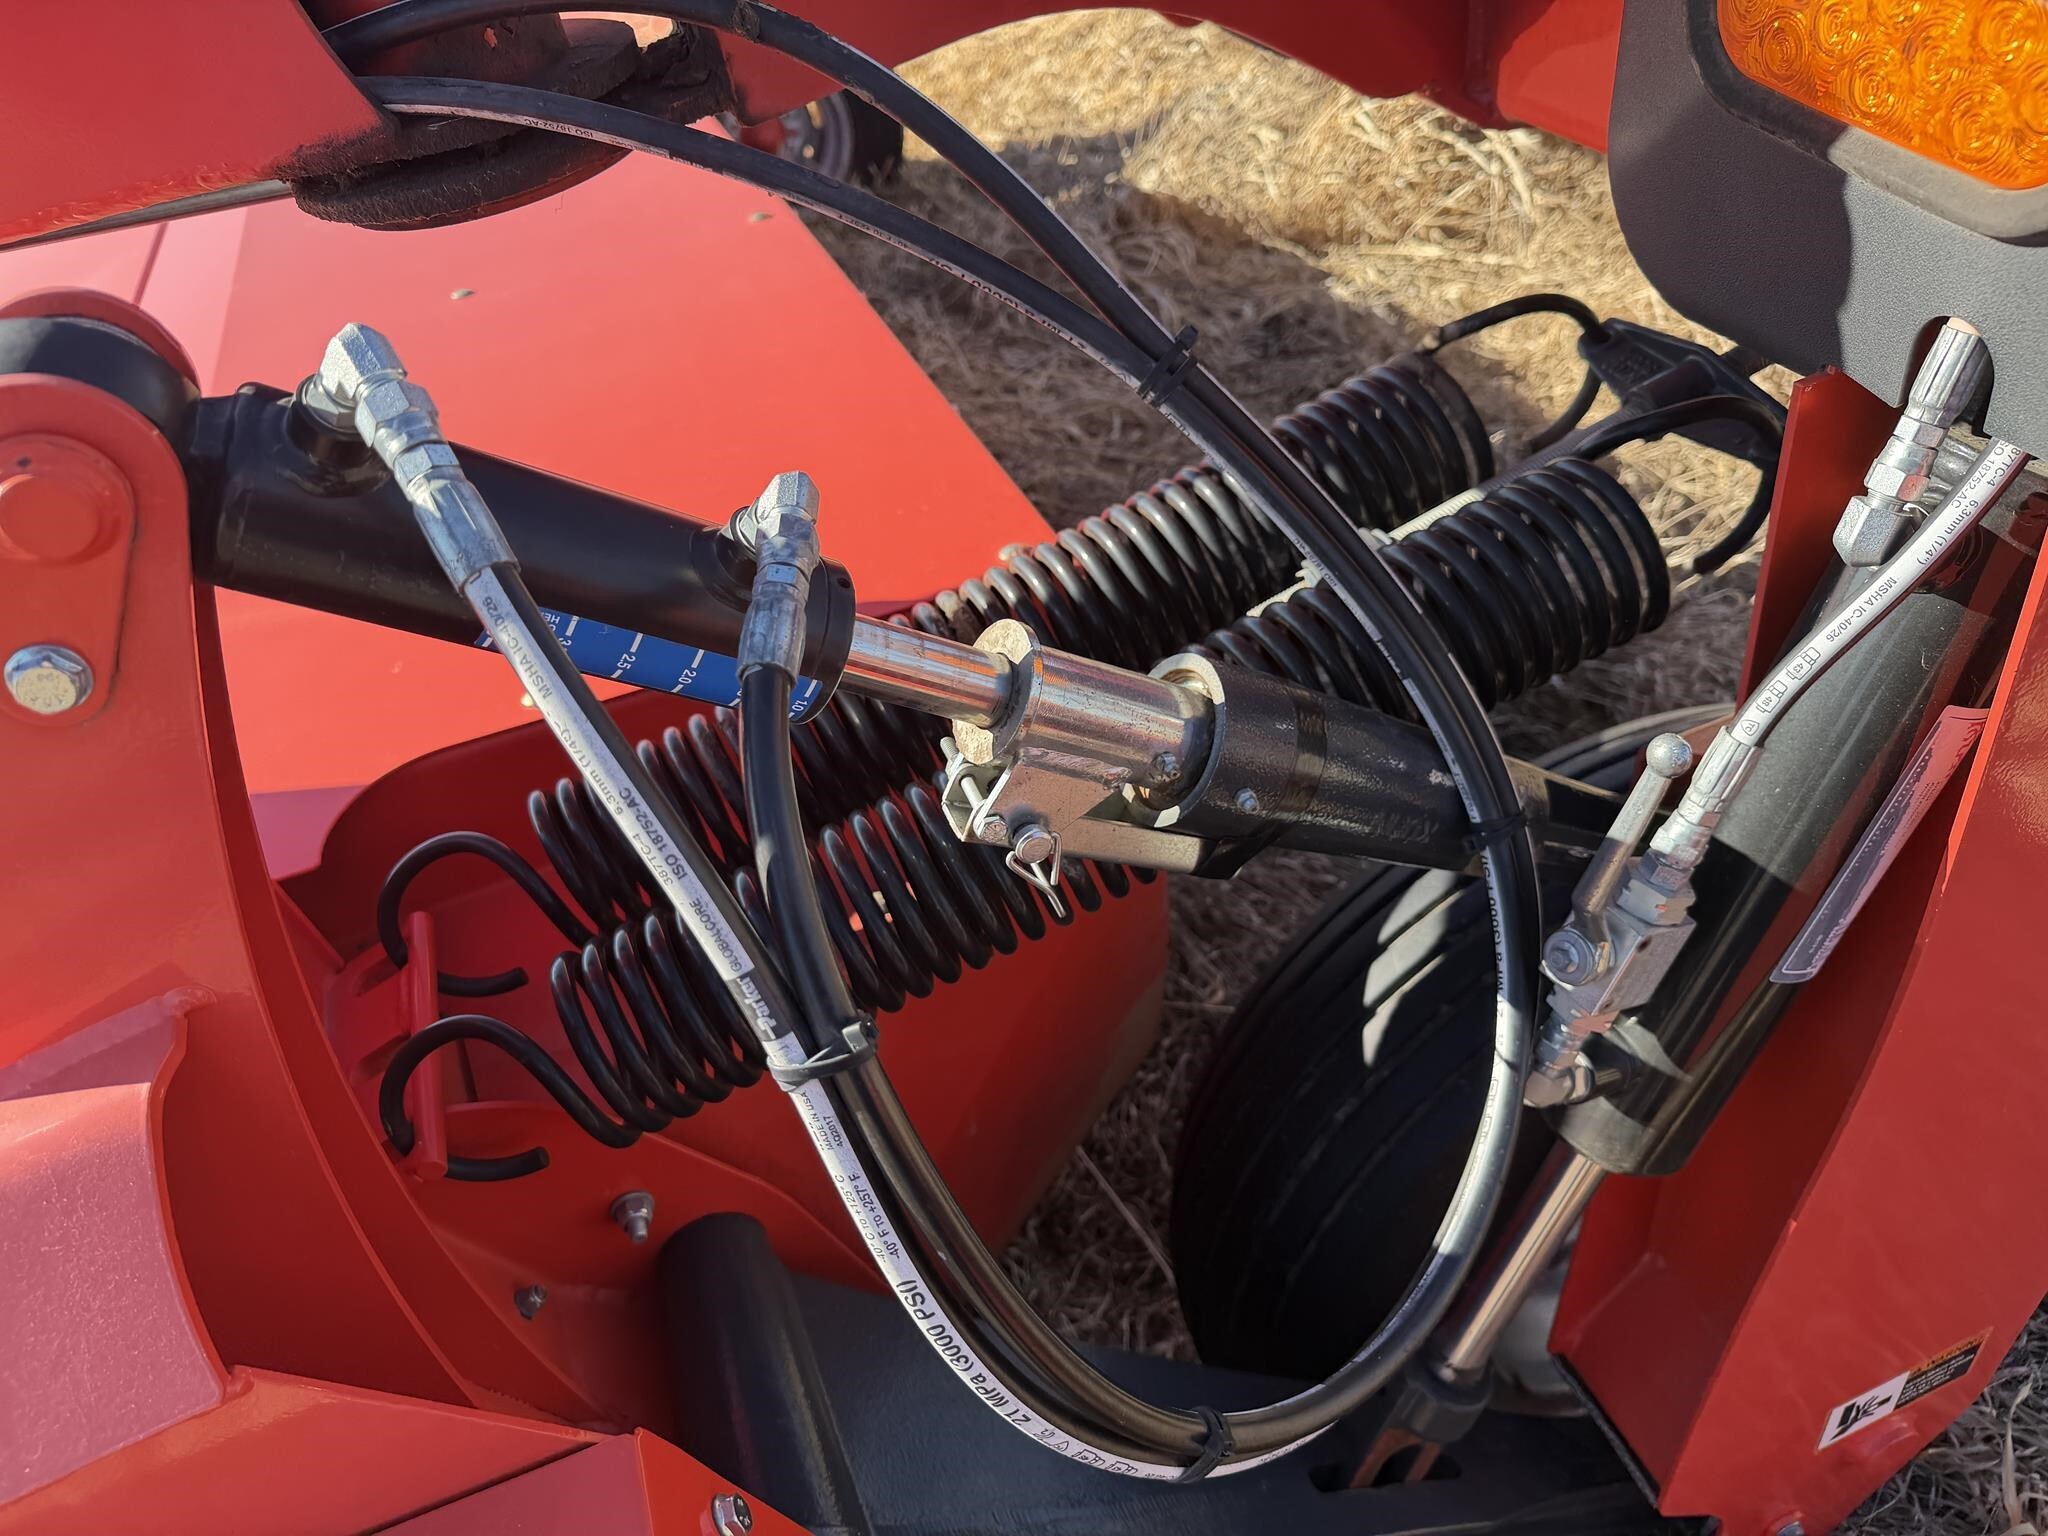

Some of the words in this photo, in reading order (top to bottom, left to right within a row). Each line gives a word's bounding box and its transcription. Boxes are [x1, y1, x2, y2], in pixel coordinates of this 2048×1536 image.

[1949, 457, 1995, 510] 18752-AC
[1863, 575, 1897, 608] MSHA
[480, 594, 522, 654] IC-40/26
[1824, 604, 1866, 643] IC-40/26
[616, 652, 635, 669] 2.5
[517, 653, 553, 699] MSHA
[677, 668, 696, 684] 2.0
[791, 699, 806, 711] 1.0
[1743, 721, 1755, 733] TC
[618, 786, 668, 851] 18752-AC
[631, 830, 673, 887] 387TC-4
[663, 852, 688, 881] ISO
[688, 896, 743, 972] GLOBALCORE
[734, 972, 777, 1032] Parker
[799, 1089, 814, 1112] USA
[809, 1111, 820, 1123] IN
[822, 1113, 844, 1148] 4Q2017
[815, 1123, 834, 1151] MADE
[833, 1172, 845, 1184] C
[847, 1171, 860, 1182] F
[872, 1213, 884, 1227] TO
[877, 1226, 889, 1238] F
[864, 1229, 875, 1242] C
[895, 1276, 935, 1325] PSI)
[925, 1320, 975, 1375] (3000
[969, 1371, 1010, 1412] MPa
[1003, 1406, 1031, 1429] 21
